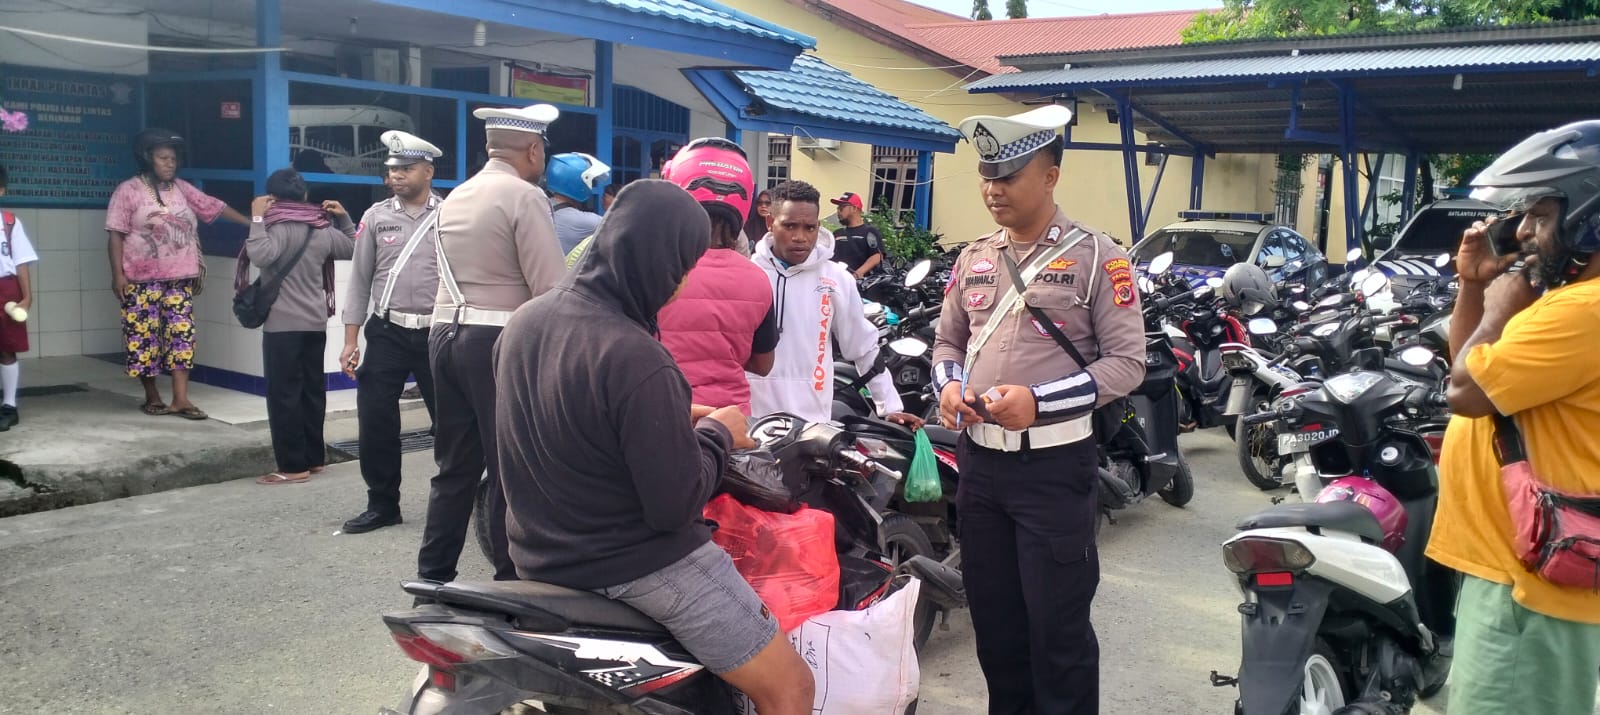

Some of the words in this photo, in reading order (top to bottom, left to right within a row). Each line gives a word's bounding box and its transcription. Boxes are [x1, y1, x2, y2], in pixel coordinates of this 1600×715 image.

[378, 225, 402, 233] DAIMOI
[1034, 273, 1075, 285] POLRI
[814, 294, 831, 391] ROADRACE
